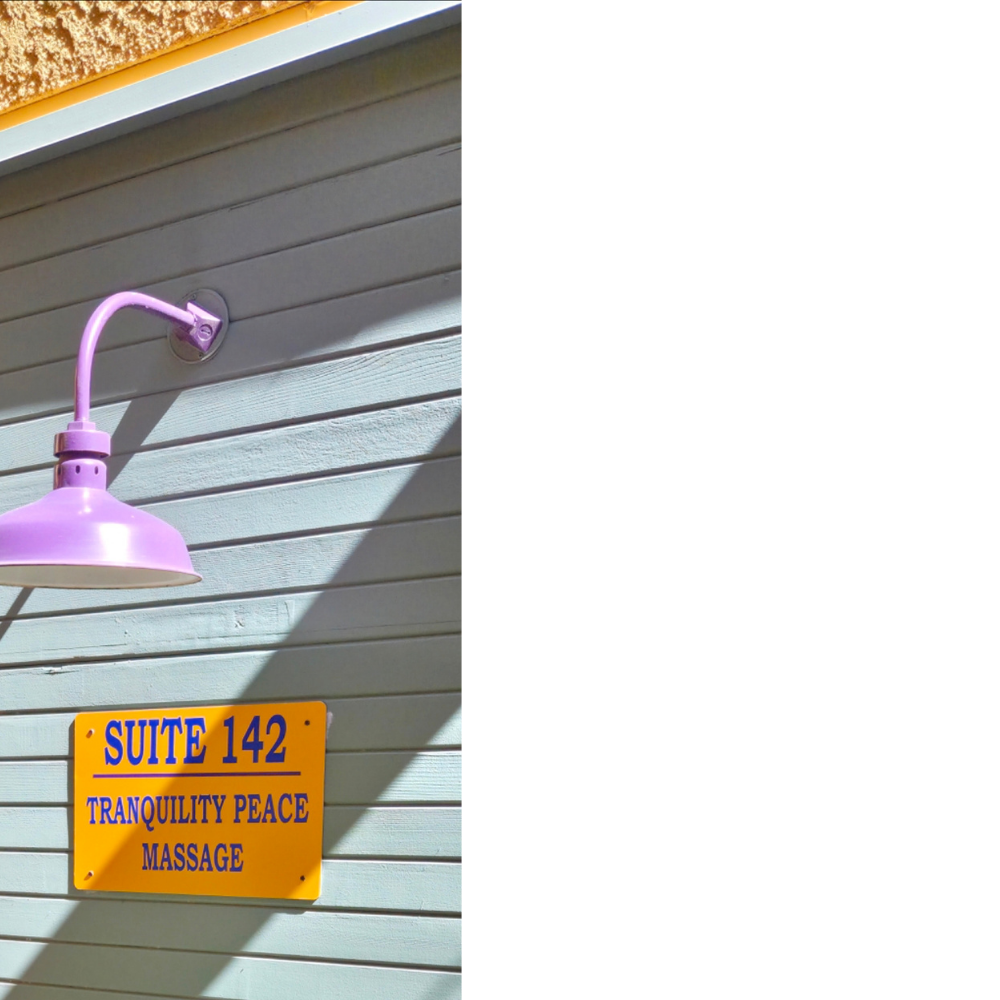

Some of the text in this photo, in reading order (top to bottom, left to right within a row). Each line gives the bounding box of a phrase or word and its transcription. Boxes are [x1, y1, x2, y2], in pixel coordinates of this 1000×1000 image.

[104, 714, 287, 766] SUITE 142
[86, 793, 309, 832] TRANQUILITY PEACE
[141, 843, 244, 873] MASSAGE
